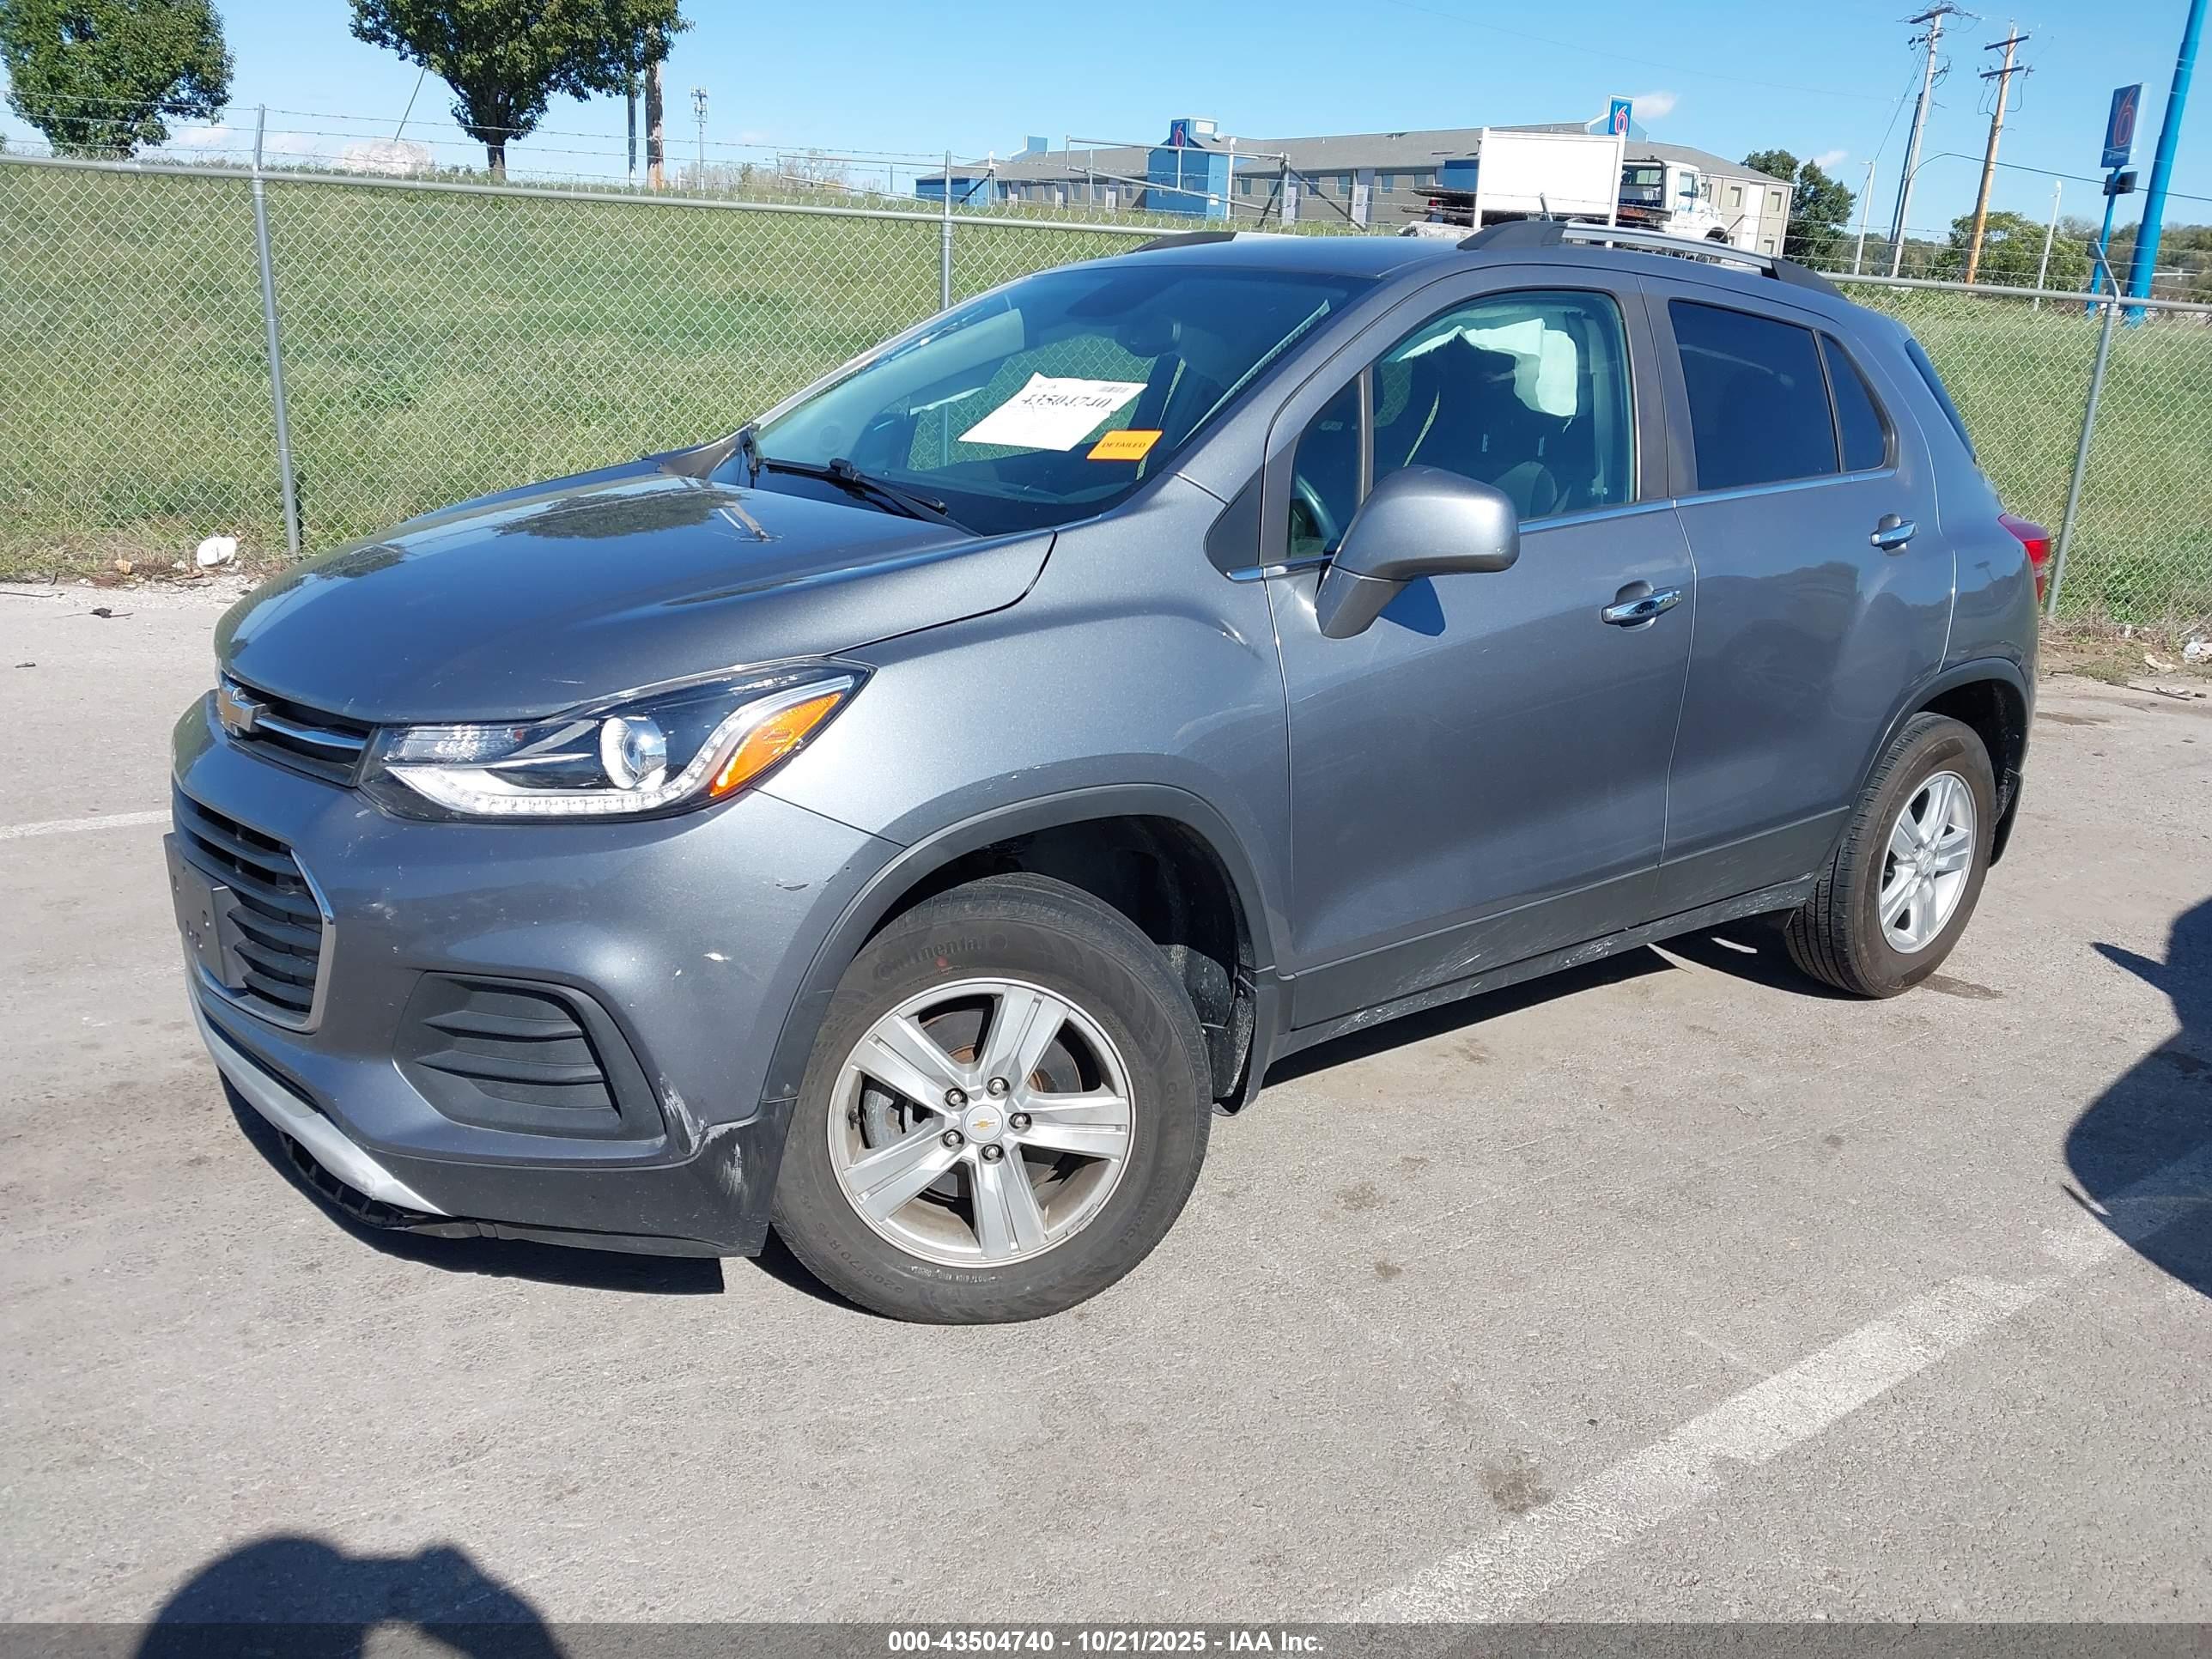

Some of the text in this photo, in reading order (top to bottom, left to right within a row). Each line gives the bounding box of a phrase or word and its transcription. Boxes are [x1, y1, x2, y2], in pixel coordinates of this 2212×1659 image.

[1614, 105, 1629, 134] 6
[2114, 88, 2136, 148] 6
[1174, 123, 1185, 148] 6
[1101, 441, 1146, 449] DETAILED
